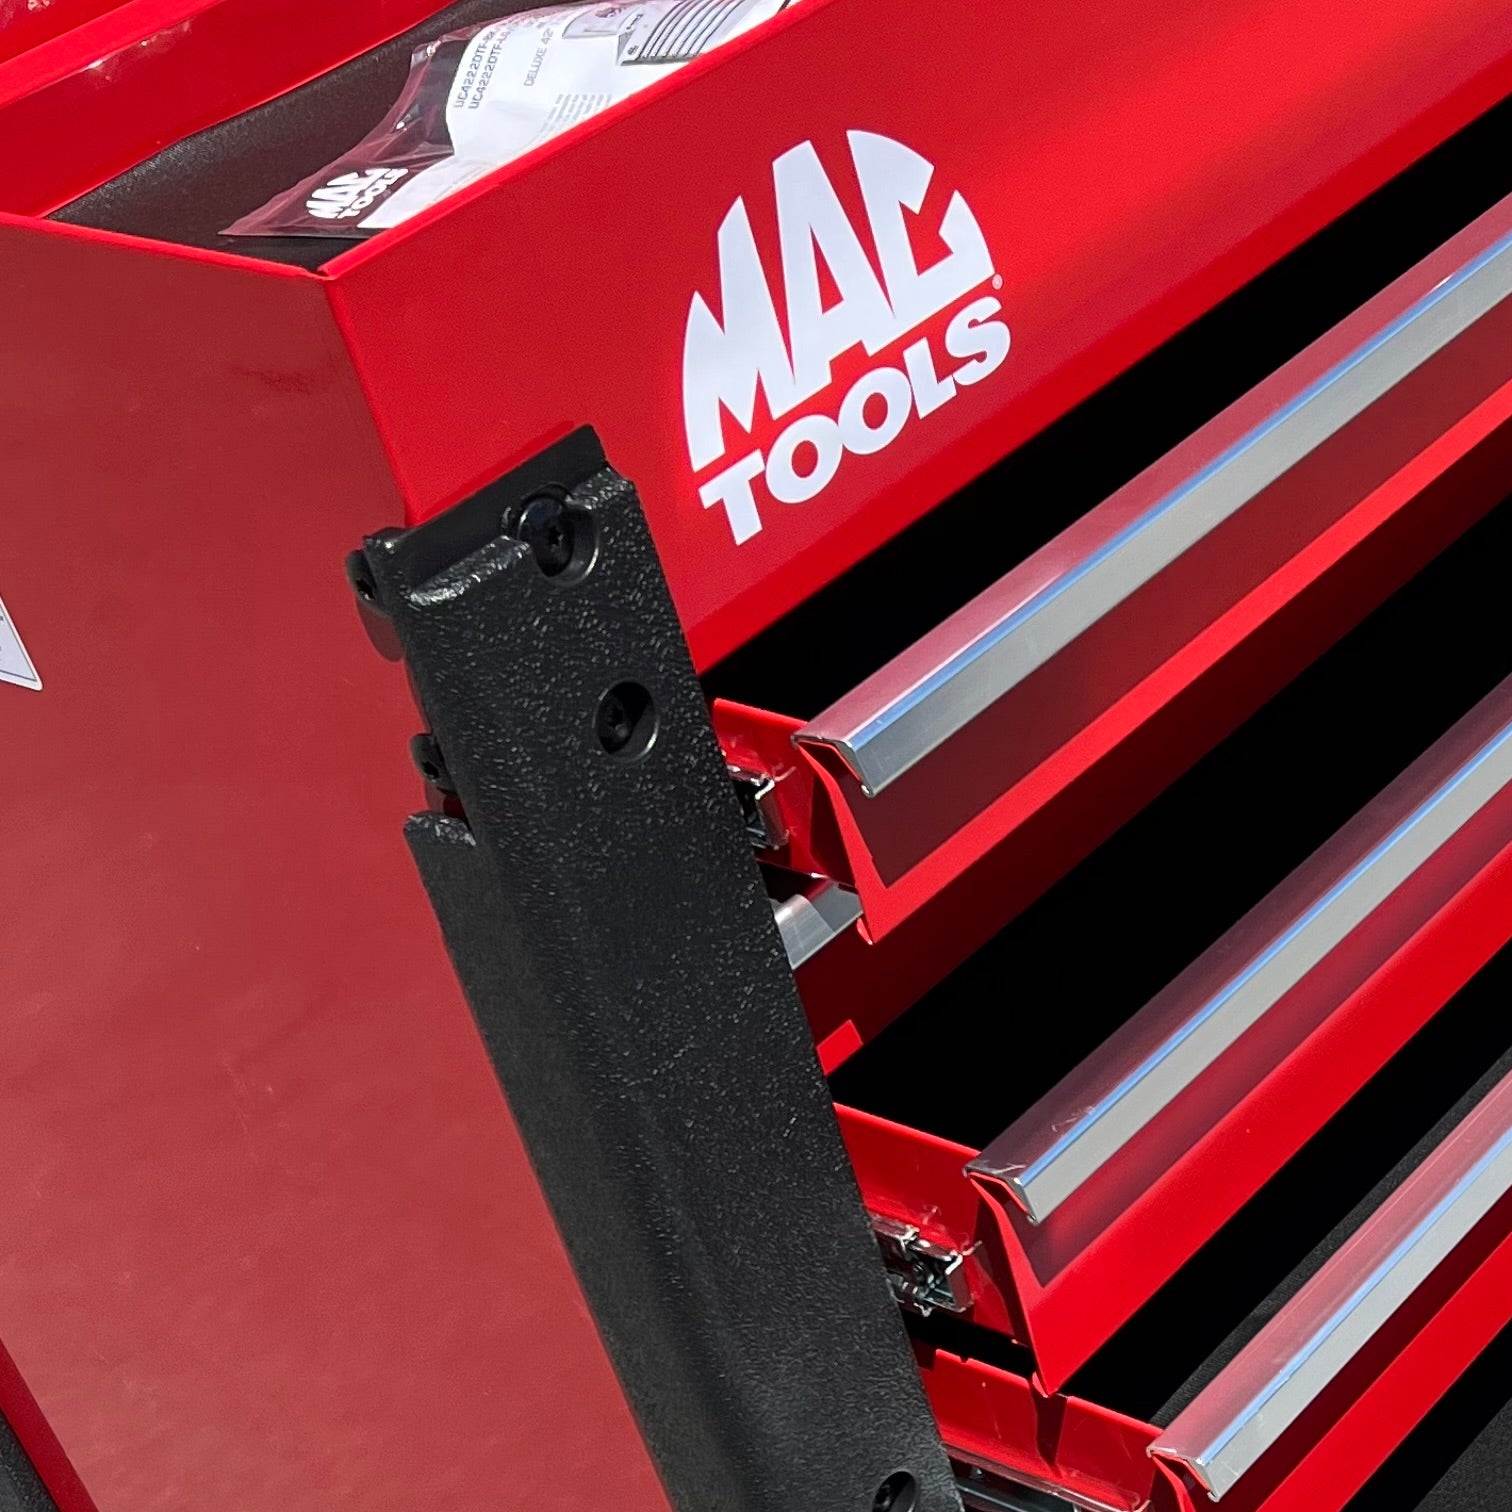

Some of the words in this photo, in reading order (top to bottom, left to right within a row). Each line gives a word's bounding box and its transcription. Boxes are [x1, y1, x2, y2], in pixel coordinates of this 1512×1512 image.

[523, 47, 548, 87] DELUXE
[306, 168, 392, 219] MAC
[337, 168, 408, 219] TOOLS
[682, 129, 995, 472] MAC
[698, 297, 1011, 546] TOOLS
